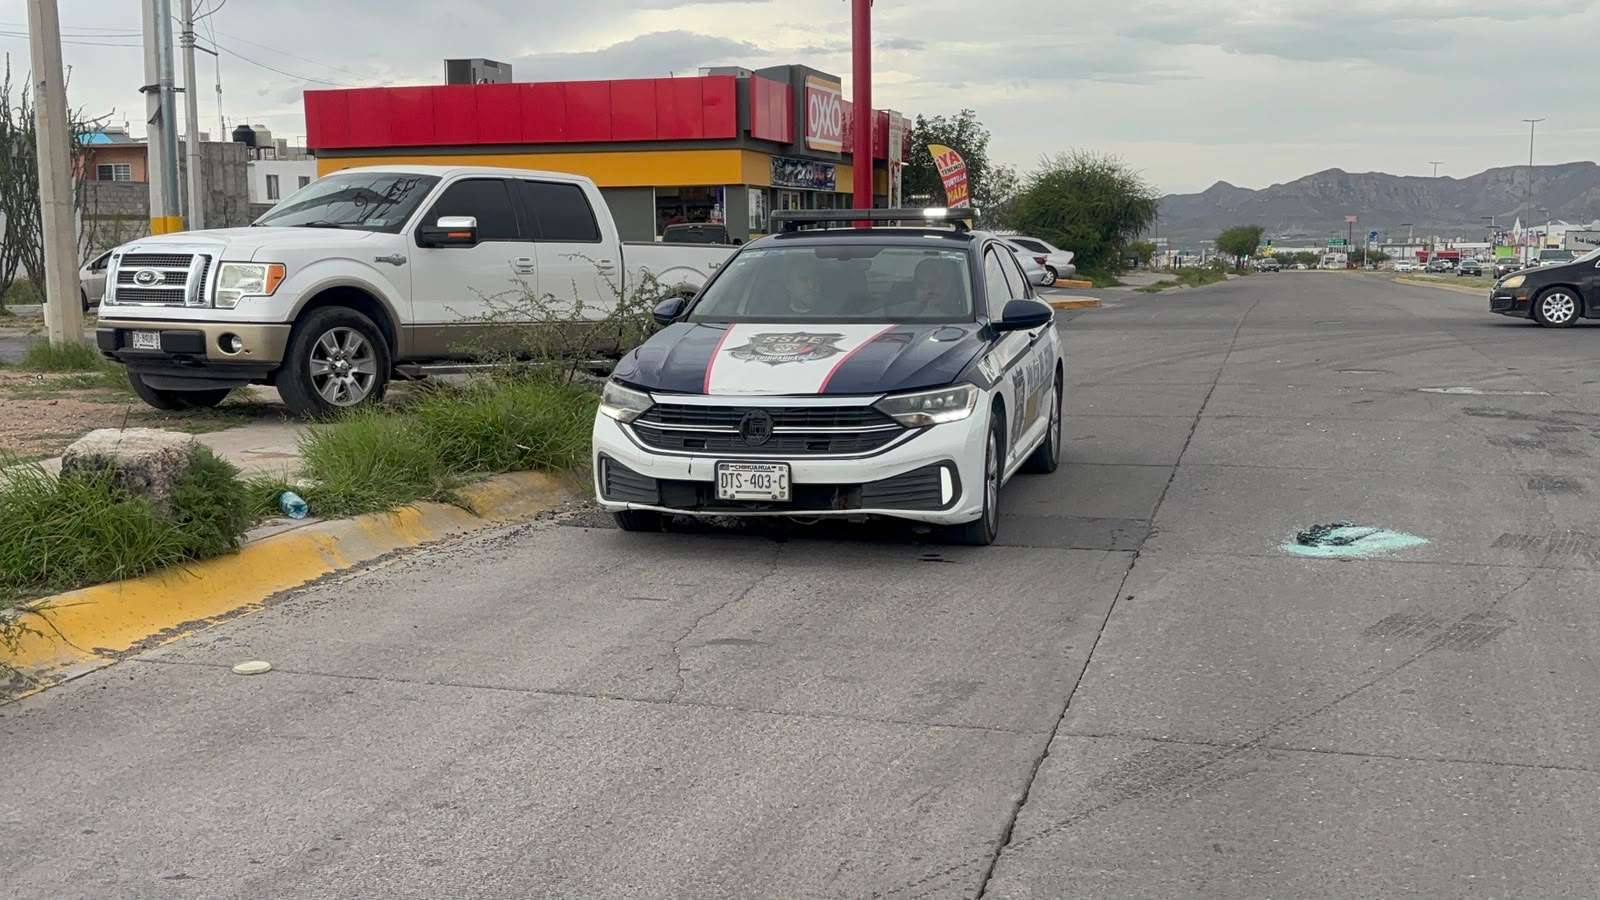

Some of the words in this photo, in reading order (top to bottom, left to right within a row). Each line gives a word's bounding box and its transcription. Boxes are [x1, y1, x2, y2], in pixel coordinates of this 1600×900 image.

[810, 93, 841, 138] OXXO
[763, 335, 824, 344] SSPE
[720, 472, 787, 490] DTS-403-C
